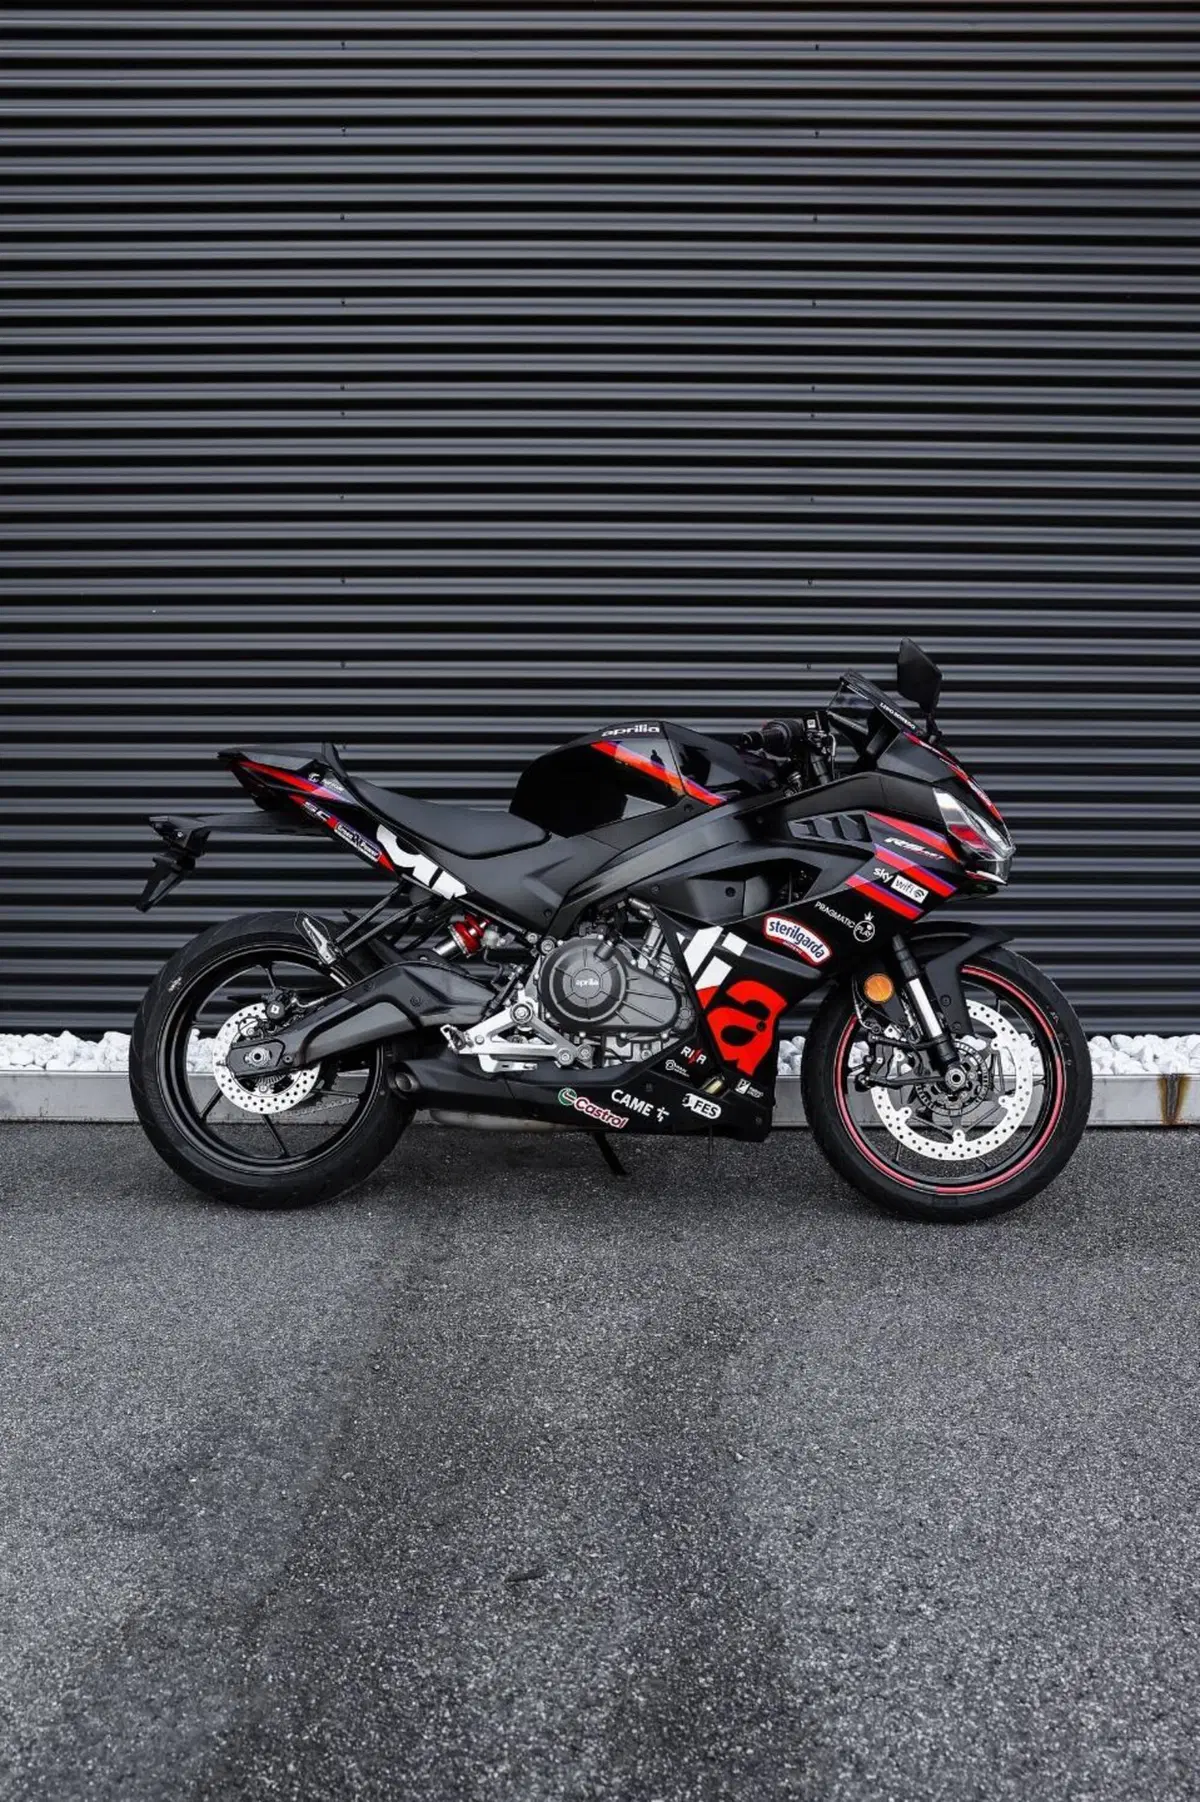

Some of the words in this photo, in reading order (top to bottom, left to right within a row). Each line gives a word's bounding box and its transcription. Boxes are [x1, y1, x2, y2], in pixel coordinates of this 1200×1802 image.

[601, 724, 661, 737] aprilia
[873, 867, 894, 883] sky
[814, 901, 856, 928] PRAGMATIC
[768, 920, 826, 959] sterilgarda
[574, 1097, 629, 1129] Castrol
[611, 1089, 654, 1116] CAME
